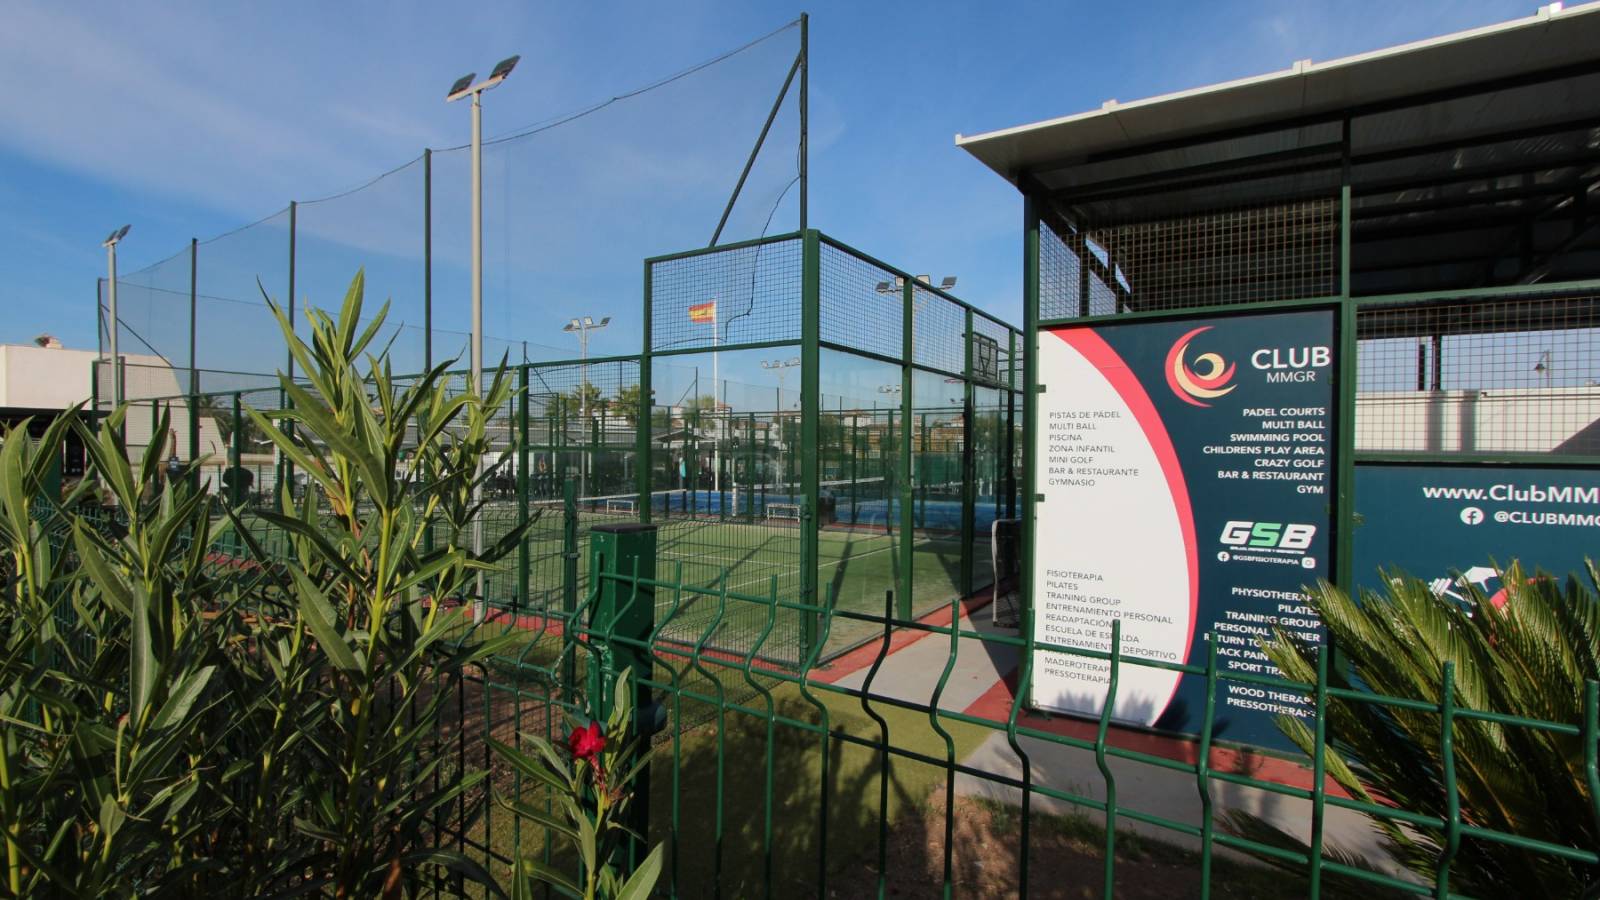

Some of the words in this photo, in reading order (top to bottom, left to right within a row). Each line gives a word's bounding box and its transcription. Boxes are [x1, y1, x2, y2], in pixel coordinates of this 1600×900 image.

[1251, 346, 1331, 370] CLUB
[1266, 371, 1316, 383] MMGR
[1049, 411, 1077, 419] PISTAS
[1079, 411, 1091, 419] DE
[1243, 408, 1277, 417] PADEL
[1280, 407, 1325, 416] COURTS
[1076, 422, 1096, 430] BALL
[1262, 421, 1294, 429] MULTI
[1297, 420, 1325, 429] BALL
[1230, 433, 1290, 442] SWIMMING
[1293, 433, 1325, 442] POOL
[1076, 445, 1115, 453] INFANTIL
[1203, 446, 1261, 454] CHILDRENS
[1264, 446, 1291, 455] PLAY
[1293, 446, 1325, 455] AREA
[1070, 456, 1094, 464] GOLF
[1254, 458, 1291, 467] CRAZY
[1293, 459, 1325, 468] GOLF
[1076, 468, 1139, 476] RESTAURANTE
[1217, 470, 1239, 479] BAR
[1241, 470, 1249, 479] &
[1252, 471, 1325, 480] RESTAURANT
[1048, 479, 1095, 487] GYMNASIO
[1296, 485, 1324, 494] GYM
[1423, 484, 1599, 504] www.ClubMM
[1220, 520, 1317, 549] GSB
[1046, 569, 1104, 582] FISIOTERAPIA
[1046, 581, 1078, 591] PILATES
[1046, 591, 1087, 603] TRAINING
[1089, 596, 1121, 606] GROUP
[1046, 602, 1121, 618] ENTRENAMIENTO
[1124, 612, 1173, 624] PERSONAL
[1225, 611, 1277, 624] TRAINING
[1280, 617, 1321, 629] GROUP
[1045, 624, 1082, 636] ESCUELA
[1085, 629, 1097, 638] DE
[1100, 631, 1140, 643] ESLDA
[1214, 622, 1270, 636] PERSONAL
[1203, 632, 1246, 646] RTURN
[1247, 638, 1262, 648] TO
[1045, 635, 1113, 651] ENTRENAMIENT
[1122, 646, 1177, 660] DEPORTIVO
[1216, 646, 1242, 658] ACK
[1243, 650, 1269, 661] PAIN
[1044, 657, 1112, 673] MADEROTERAP
[1228, 660, 1263, 673] SPORT
[1228, 684, 1265, 698] WOOD
[1267, 691, 1316, 705] THERAP
